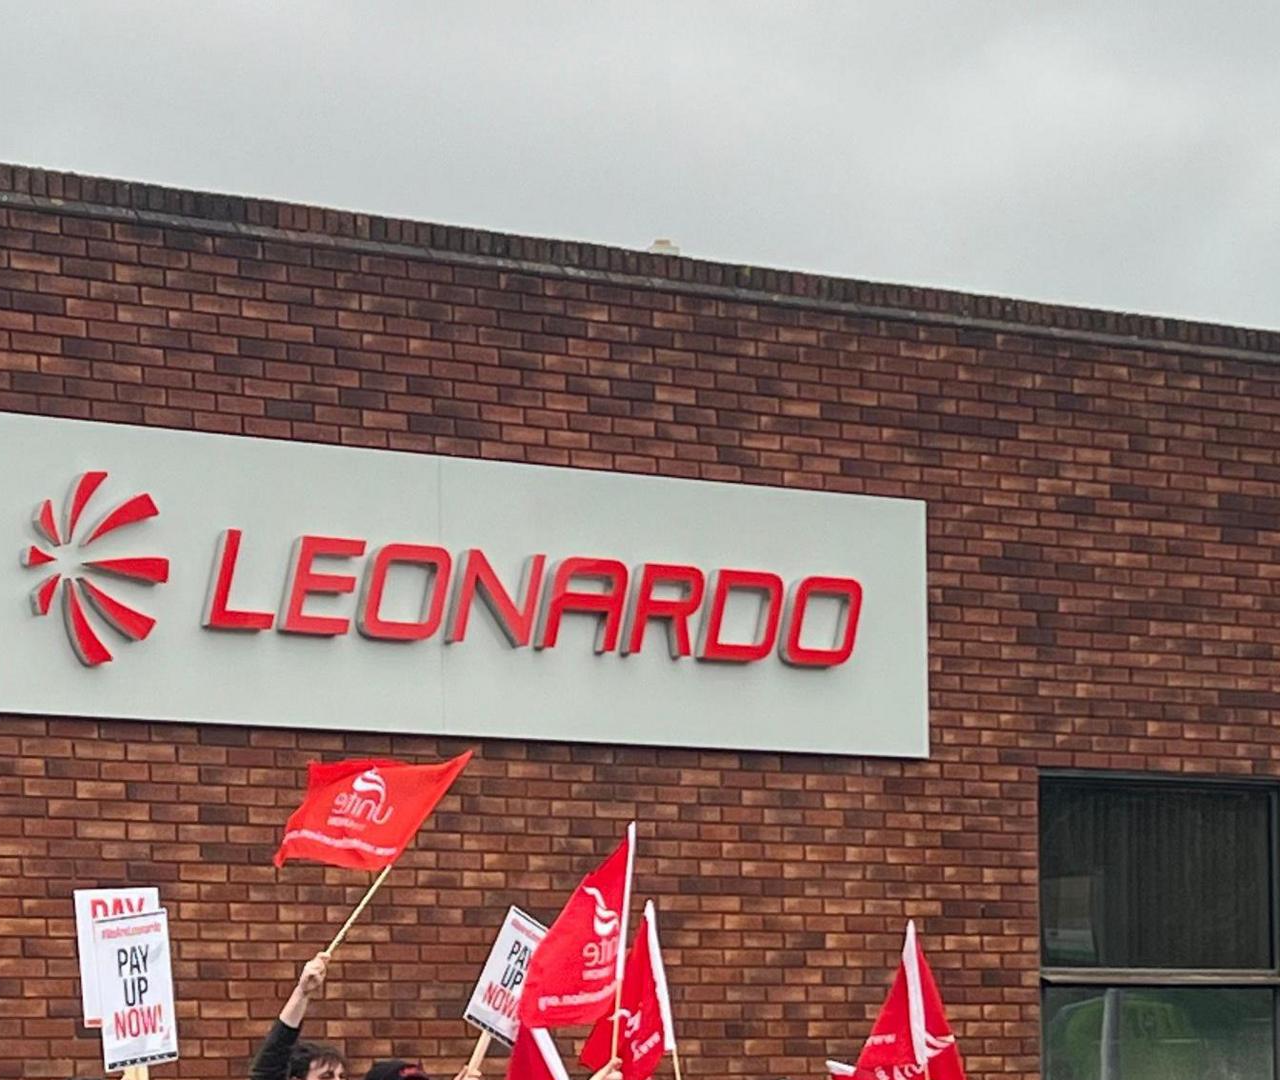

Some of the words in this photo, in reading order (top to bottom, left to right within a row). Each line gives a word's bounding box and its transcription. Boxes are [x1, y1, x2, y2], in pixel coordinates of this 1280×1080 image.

[203, 528, 864, 668] LEONARDO
[117, 944, 150, 977] PAY
[507, 940, 532, 970] PA
[123, 976, 148, 1007] UP
[501, 965, 524, 990] UP
[114, 1004, 164, 1041] NOW!
